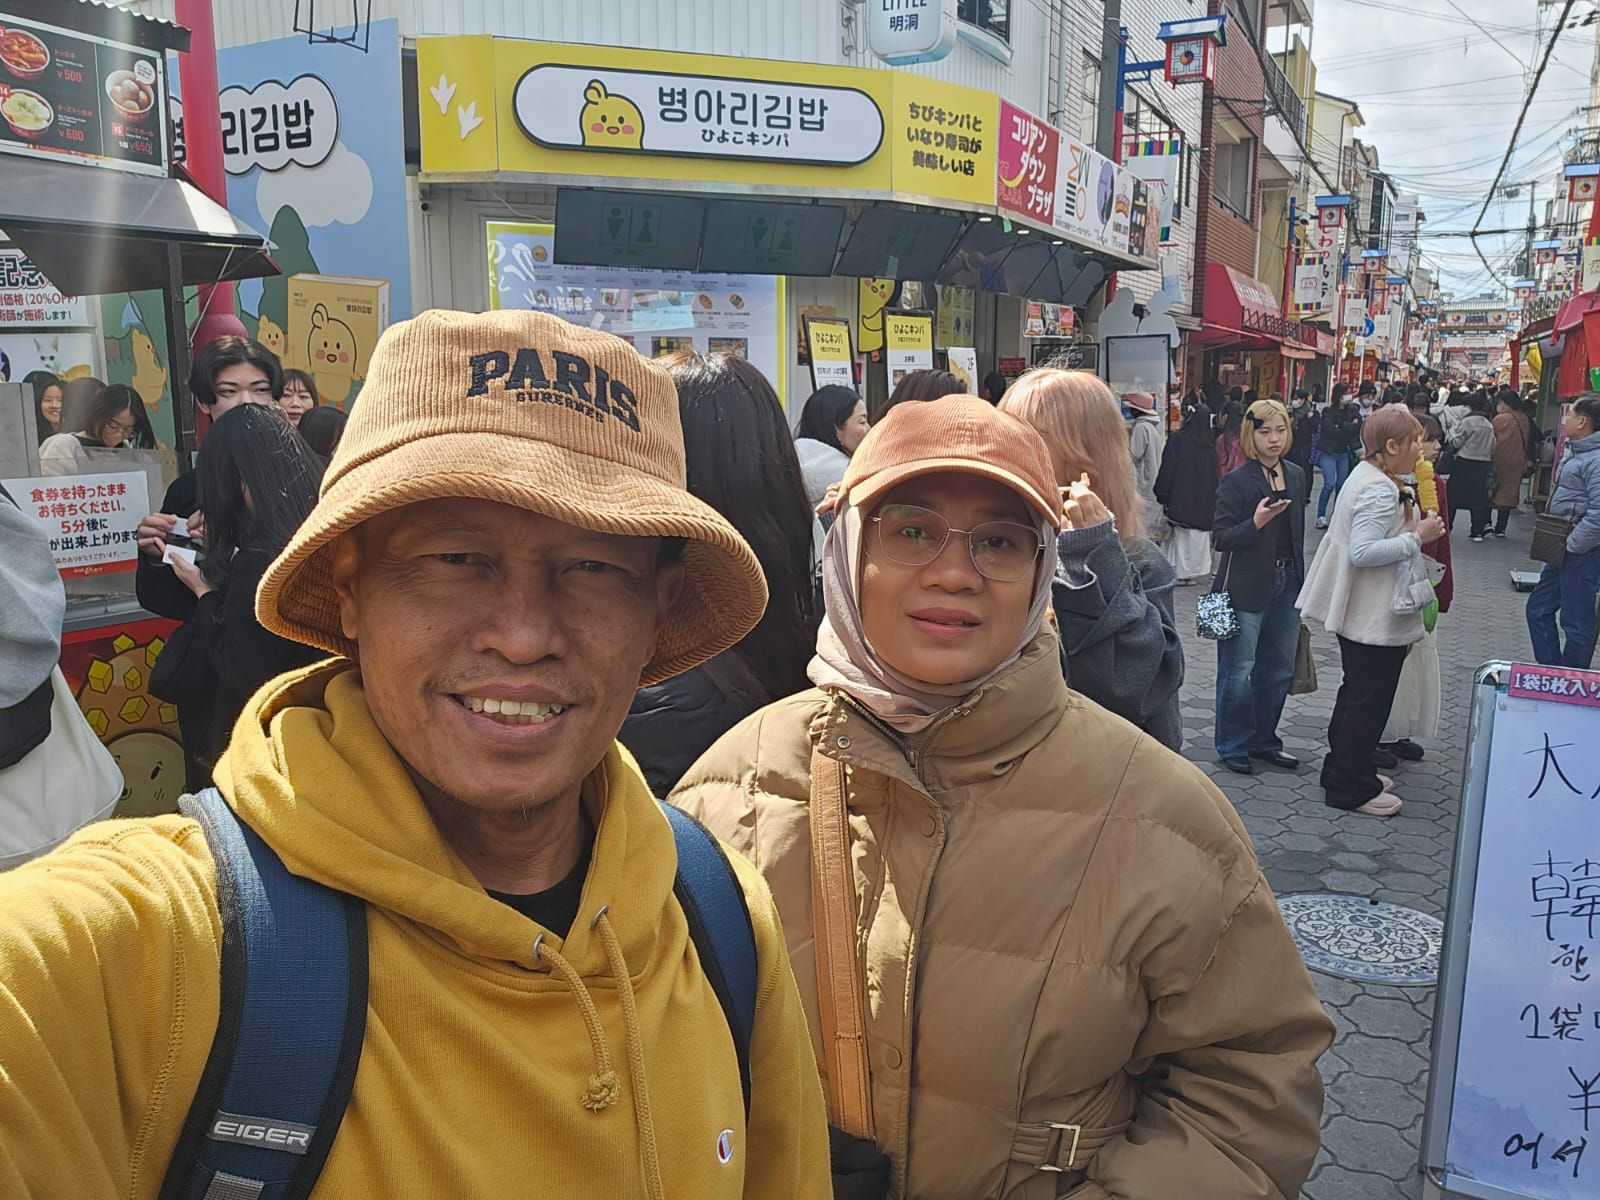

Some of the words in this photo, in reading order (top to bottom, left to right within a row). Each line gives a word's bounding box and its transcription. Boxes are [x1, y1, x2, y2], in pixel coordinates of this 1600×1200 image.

[889, 13, 919, 32] 明洞
[658, 86, 828, 132] 병아리김밥
[908, 102, 983, 132] ちびキンパと
[700, 128, 790, 147] ひよこキンパ
[907, 126, 982, 154] いなり寿司が
[1011, 114, 1048, 154] コリアン
[912, 150, 975, 176] 美味しい店
[1020, 151, 1047, 184] タウン
[1027, 184, 1054, 218] プラザ
[467, 348, 641, 432] PARIS
[30, 483, 127, 503] 食券を持ったまま
[38, 499, 126, 518] お待ちください。
[61, 518, 108, 534] 5分後に
[1523, 732, 1600, 799] 大
[213, 1120, 310, 1147] EIGER
